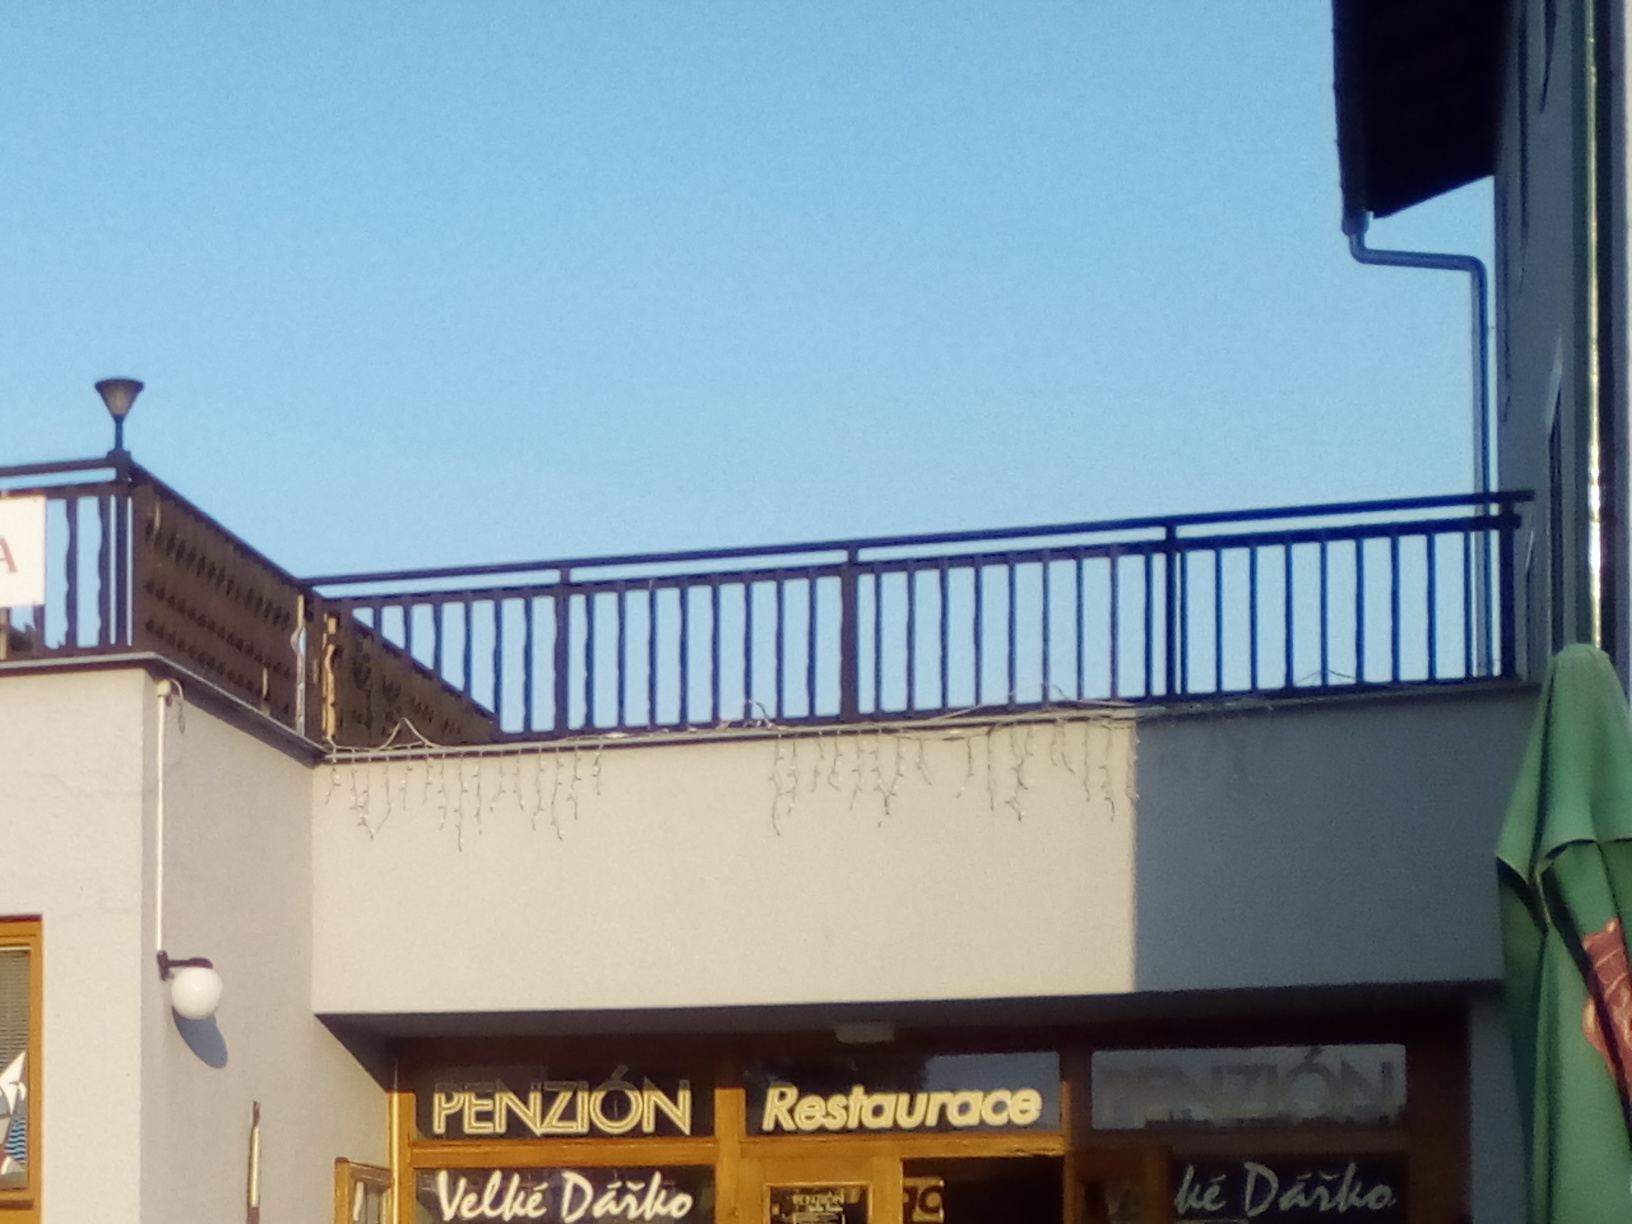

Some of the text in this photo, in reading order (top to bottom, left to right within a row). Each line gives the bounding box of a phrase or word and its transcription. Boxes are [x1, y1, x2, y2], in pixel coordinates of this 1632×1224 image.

[432, 1063, 692, 1137] PENZIÓN
[761, 1081, 1043, 1132] Restaurace
[435, 1168, 694, 1224] Velké Dářko
[1243, 1160, 1397, 1218] Dářko
